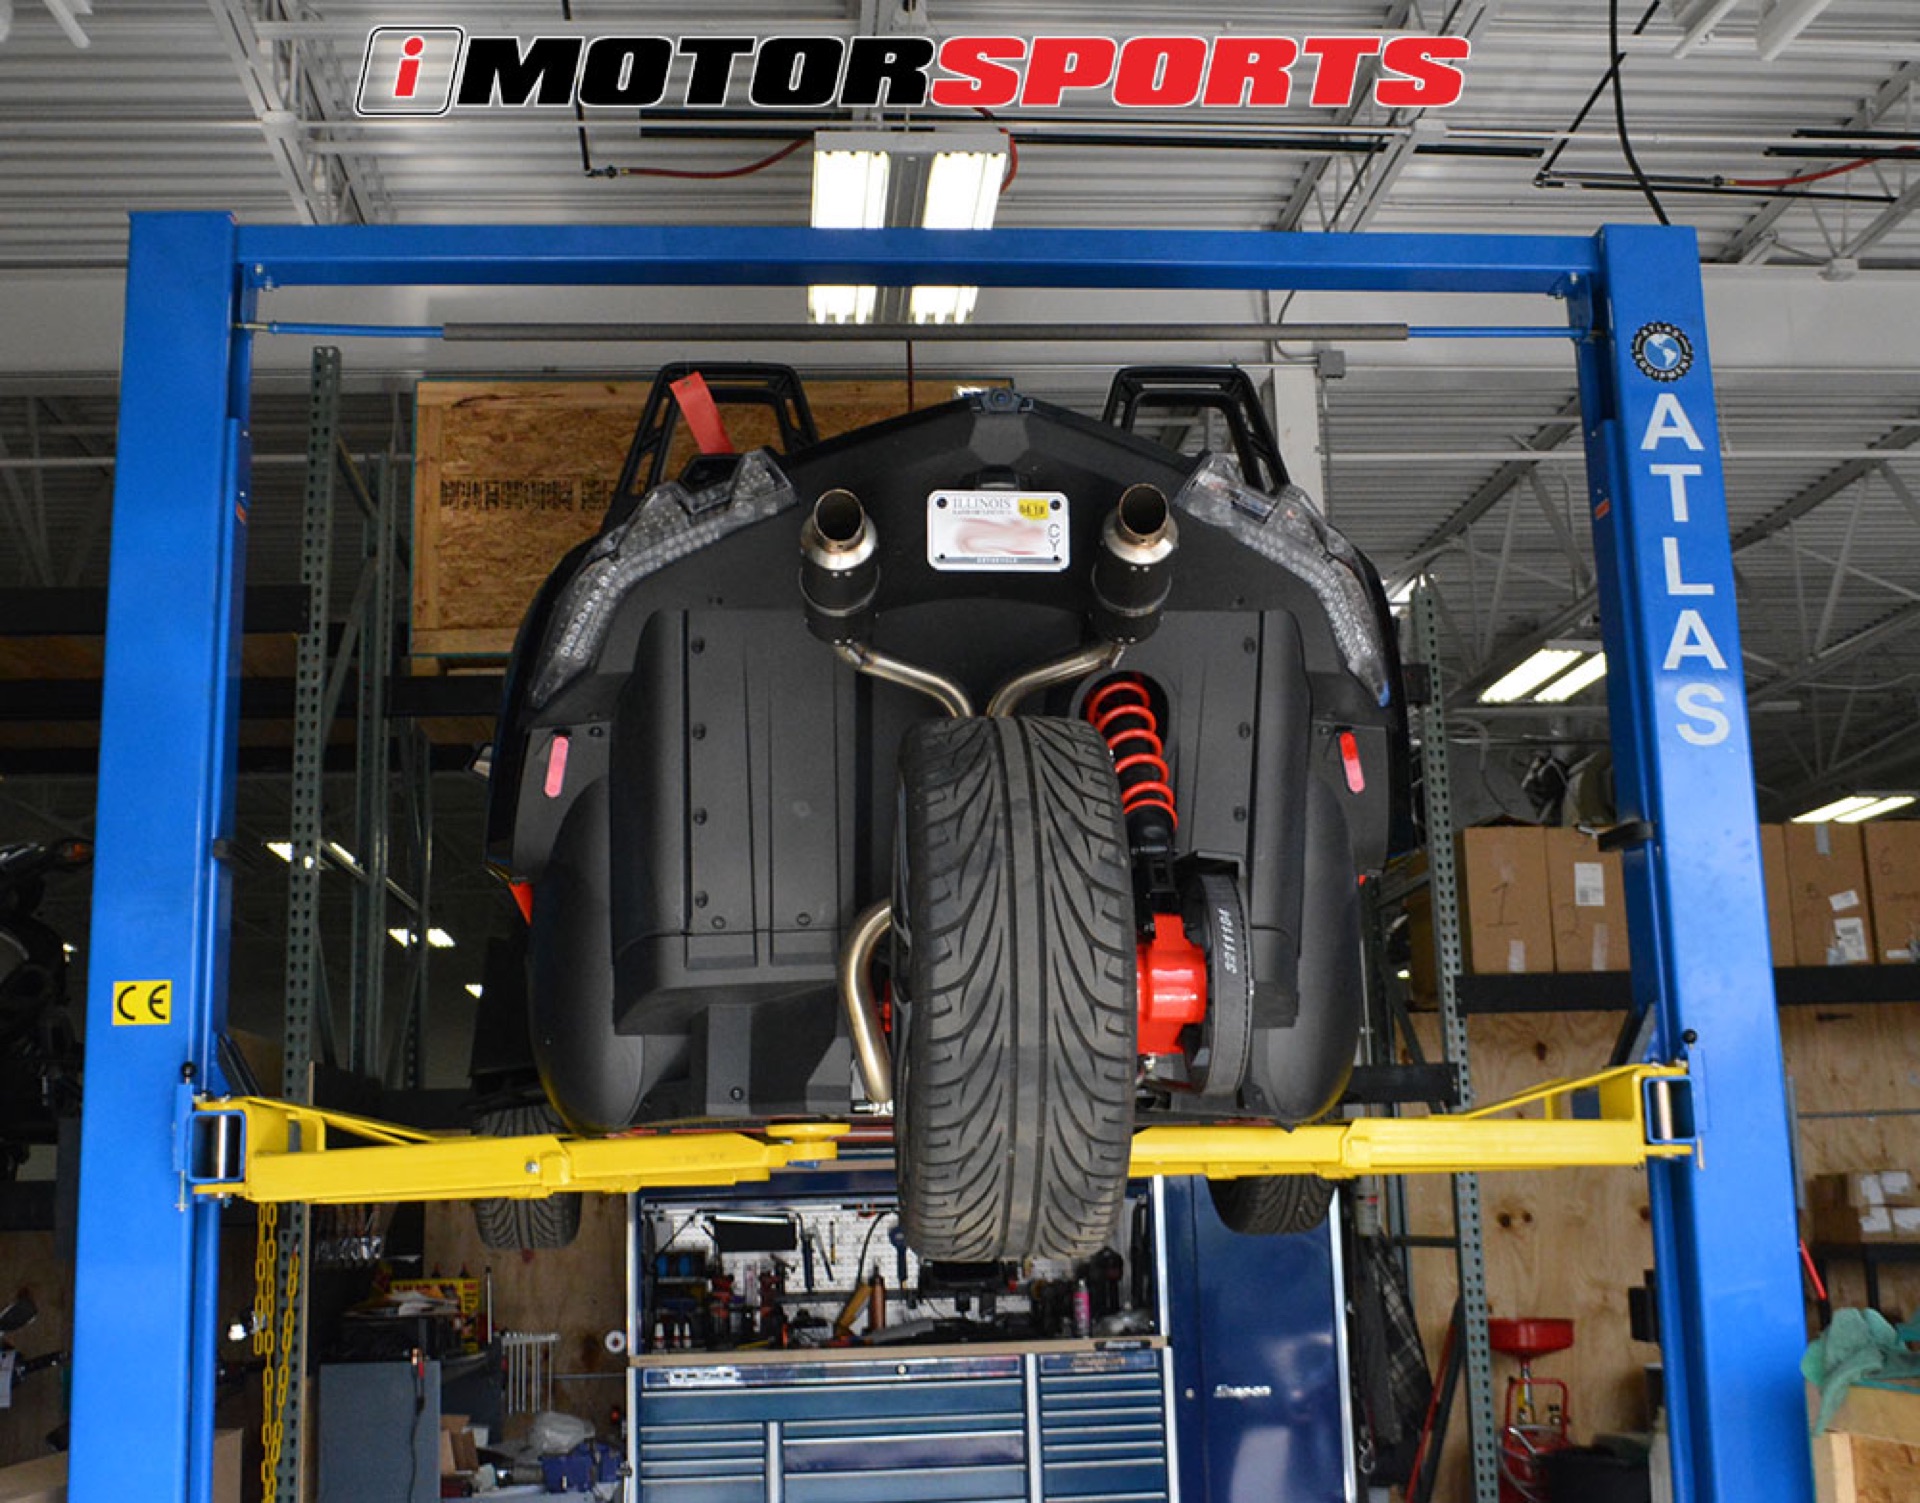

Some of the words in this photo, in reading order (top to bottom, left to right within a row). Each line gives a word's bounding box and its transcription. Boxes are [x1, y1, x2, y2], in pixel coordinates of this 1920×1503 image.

[952, 498, 1012, 509] ILLINOIS
[1640, 393, 1730, 746] ATLAS
[117, 984, 168, 1021] CE
